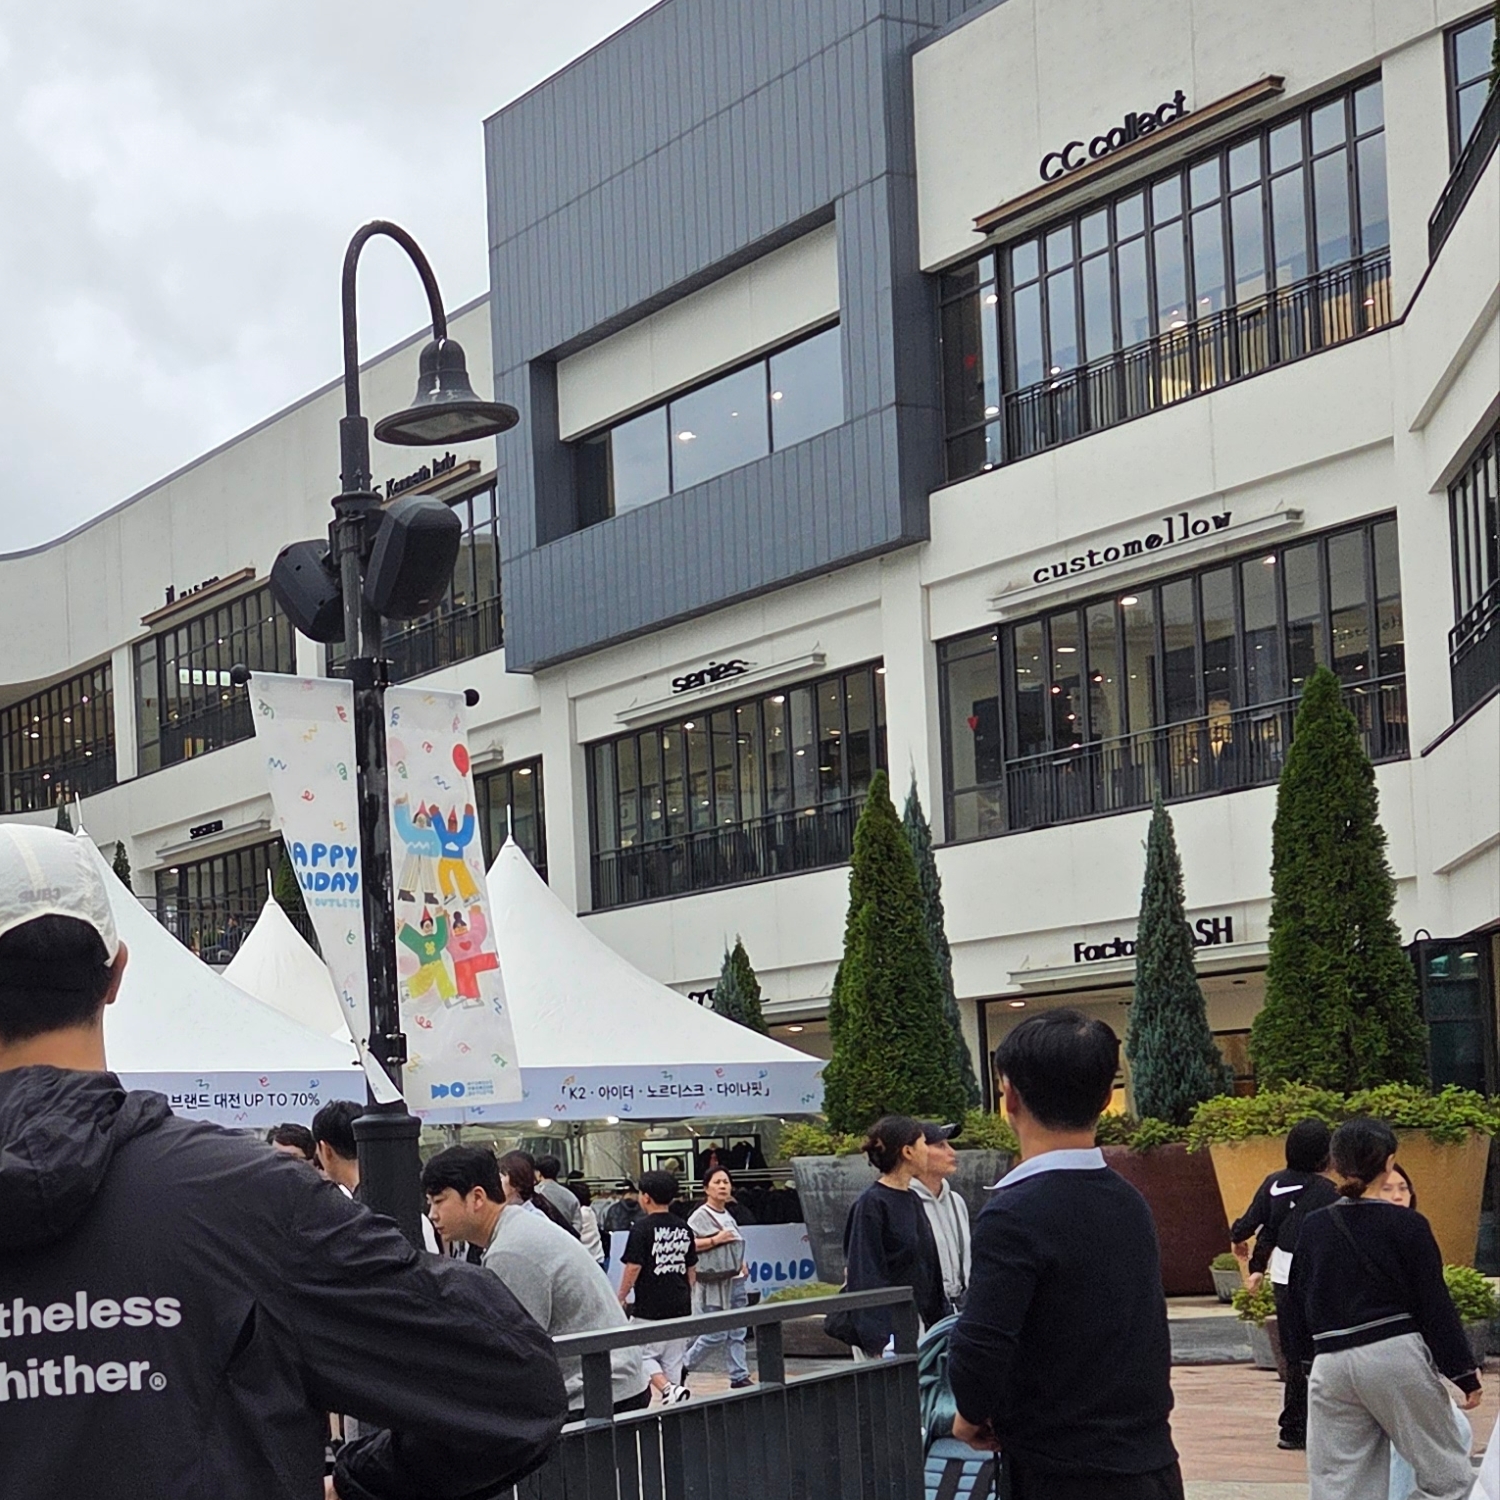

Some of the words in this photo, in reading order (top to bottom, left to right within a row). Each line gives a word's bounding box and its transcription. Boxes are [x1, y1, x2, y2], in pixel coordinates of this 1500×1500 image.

[1089, 90, 1190, 158] collect
[1033, 511, 1232, 584] customellow
[297, 871, 360, 894] LIDAY
[1073, 936, 1138, 963] Facto
[170, 1092, 211, 1109] 브랜드
[214, 1092, 241, 1109] 대전
[244, 1093, 264, 1107] UP
[267, 1093, 287, 1106] TO
[291, 1092, 321, 1107] 70%
[598, 1085, 634, 1100] 아이더
[646, 1084, 705, 1099] 노르디스크
[747, 1258, 816, 1284] HOLID
